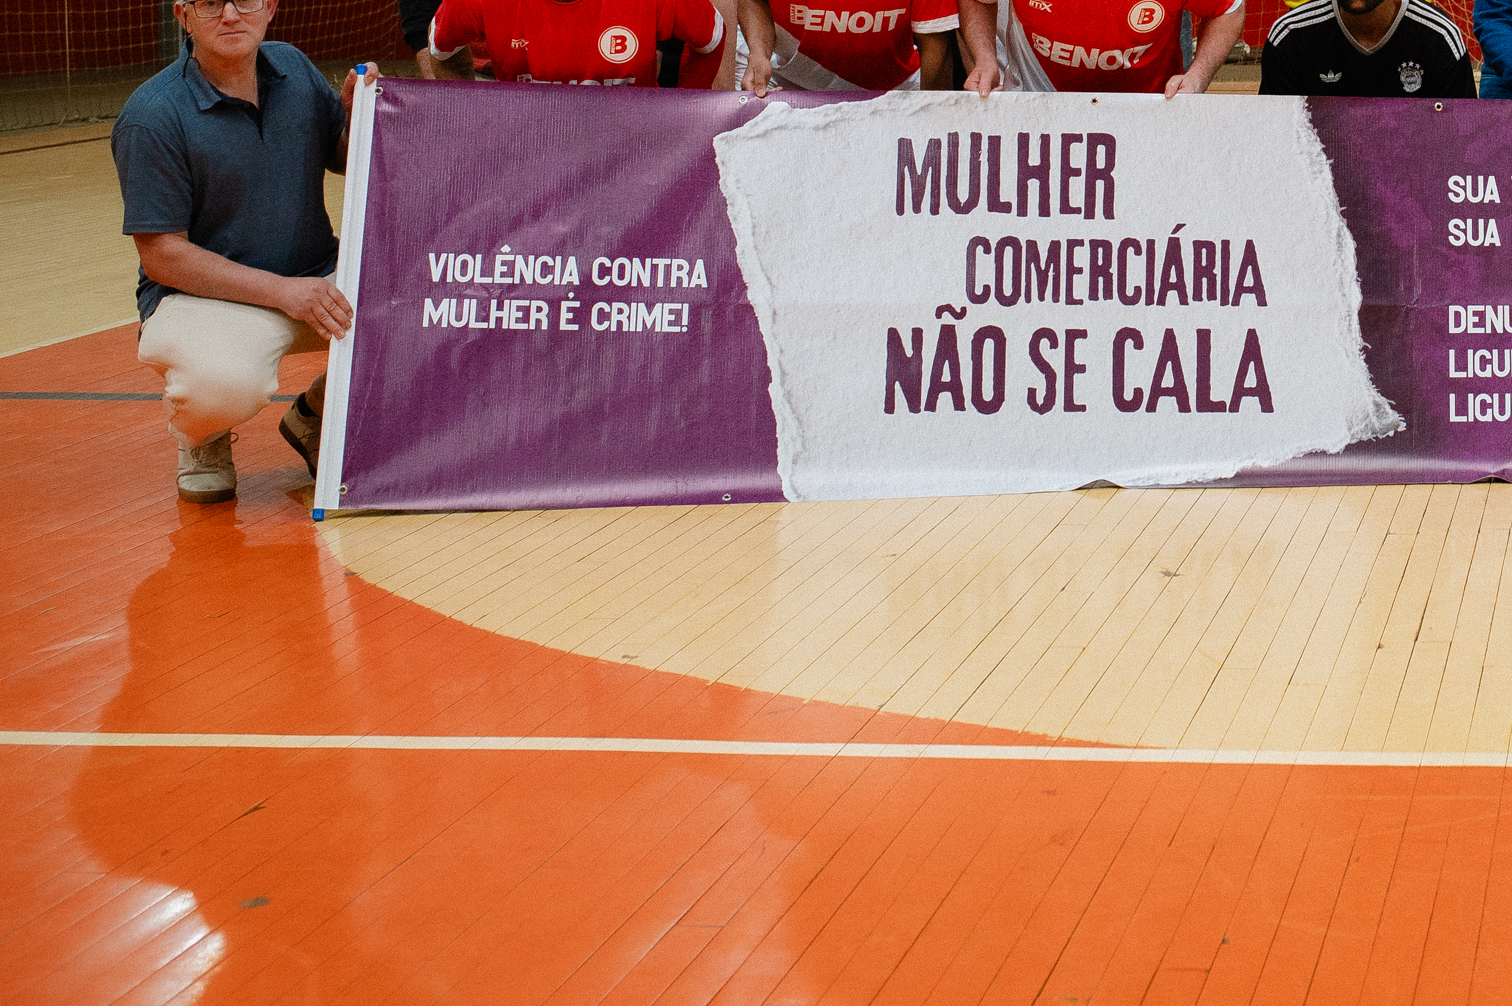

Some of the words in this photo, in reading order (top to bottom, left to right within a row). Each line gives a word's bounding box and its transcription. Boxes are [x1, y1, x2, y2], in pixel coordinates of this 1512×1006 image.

[793, 4, 907, 34] BENOIT
[1033, 33, 1154, 71] BENOIT
[895, 131, 1117, 220] MULHER
[1447, 175, 1501, 204] SUA
[1448, 218, 1502, 247] SUA
[428, 244, 580, 286] VIOLÊNCIA
[591, 256, 708, 288] CONTRA
[965, 223, 1268, 307] COMERCIÁRIA
[422, 297, 549, 331] MULHER
[559, 292, 581, 331] É
[590, 301, 689, 333] CRIME!
[883, 303, 1007, 416] NÃO
[1026, 326, 1089, 416] SE
[1111, 325, 1275, 414] CALA
